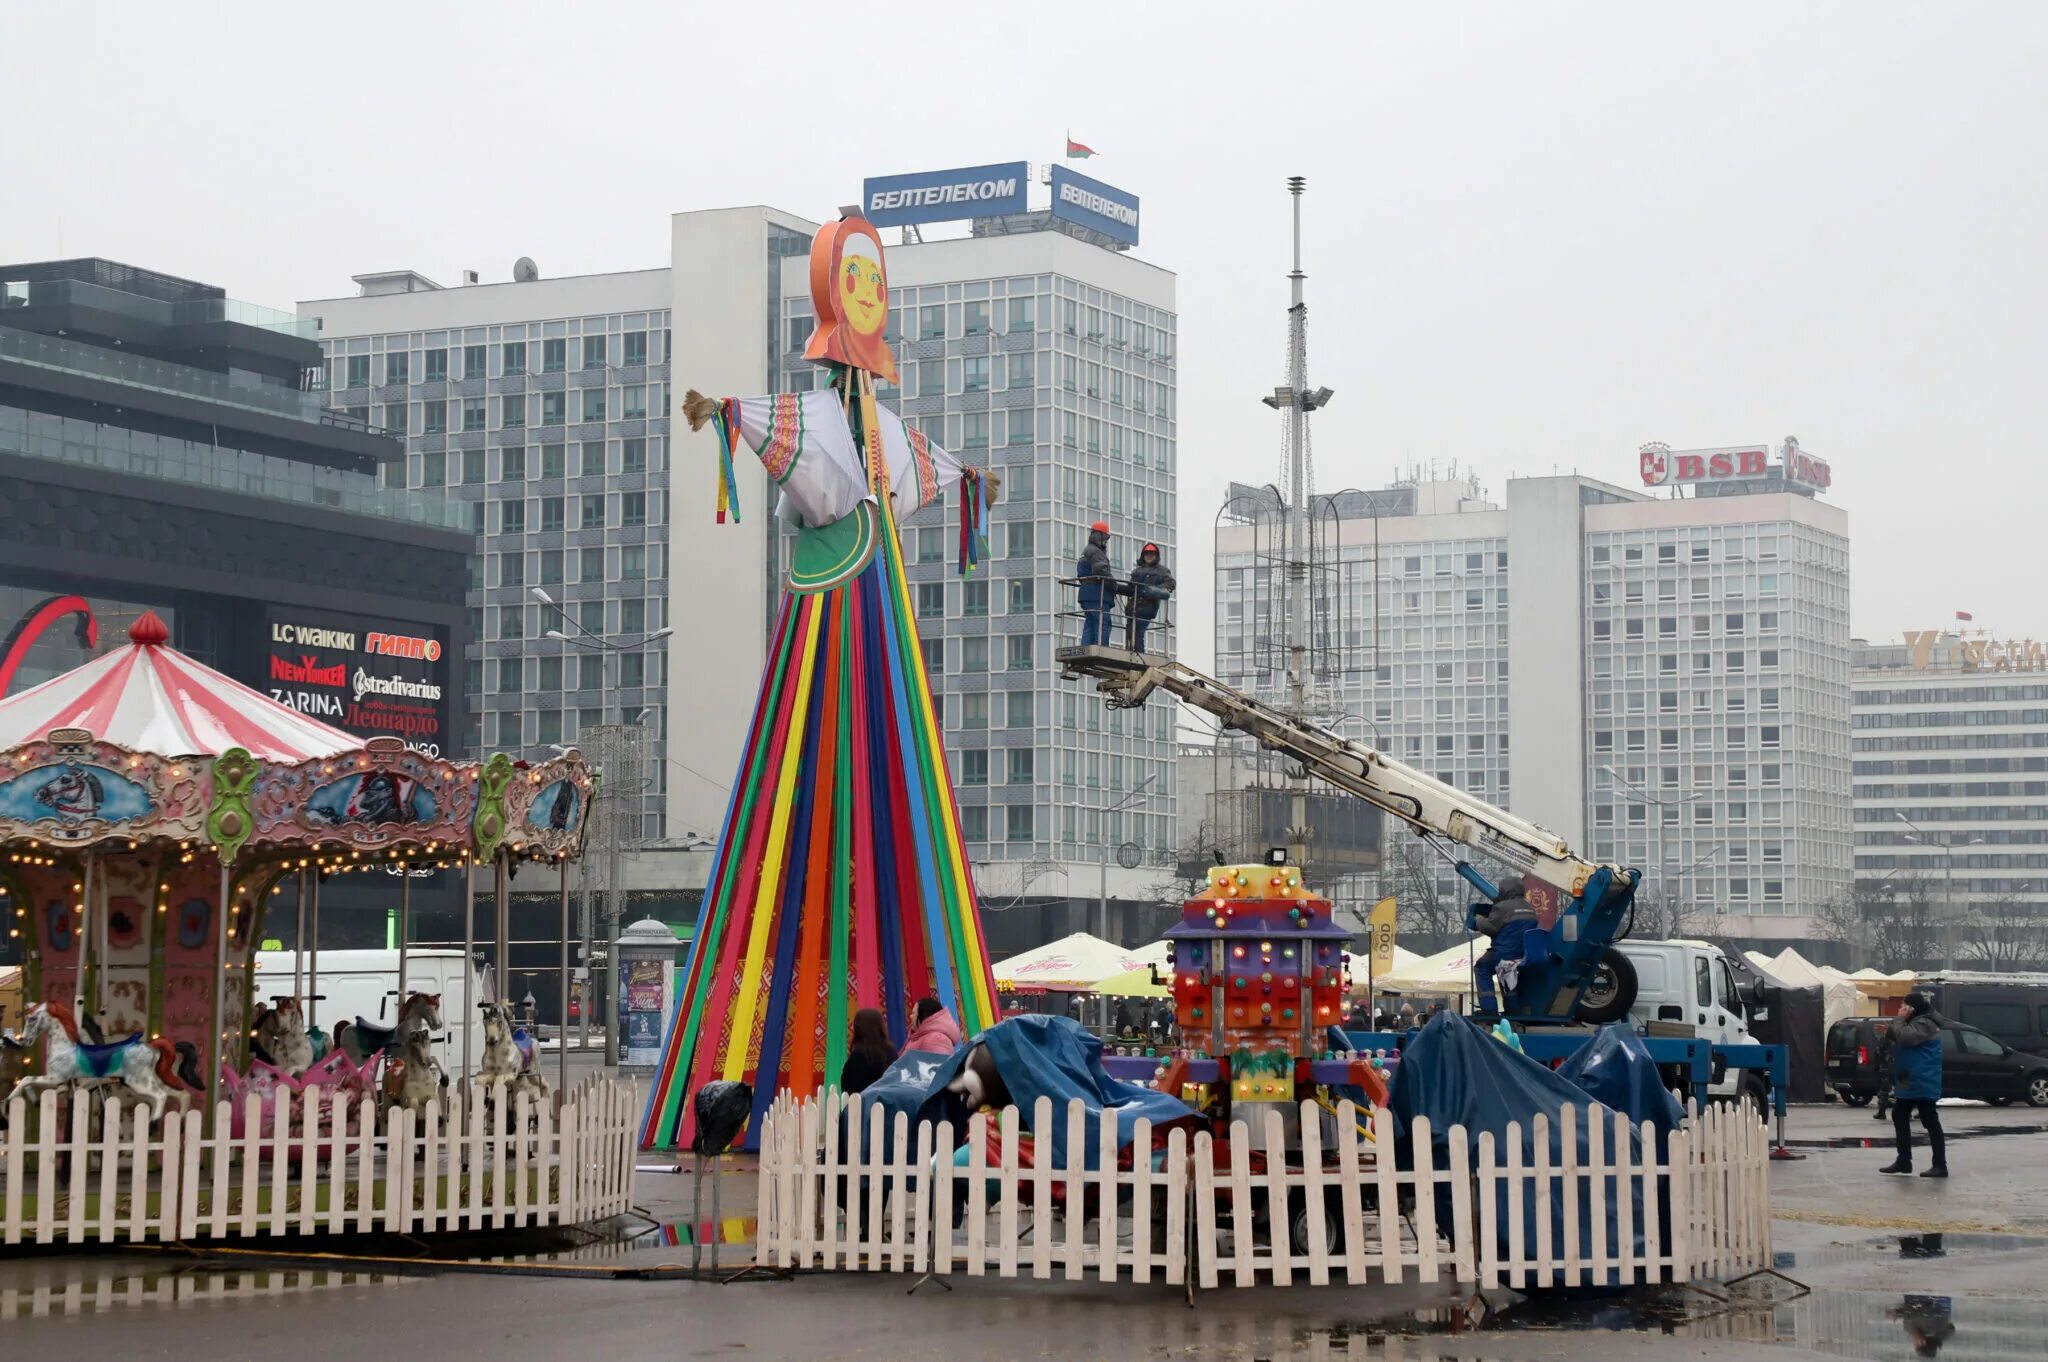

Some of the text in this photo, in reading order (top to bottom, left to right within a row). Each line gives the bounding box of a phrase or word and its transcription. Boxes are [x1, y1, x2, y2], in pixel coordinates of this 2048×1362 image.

[870, 178, 1017, 211] БЕЛТЕЛЕКОМ
[1059, 183, 1137, 227] БЕЛТЕЛЕКОМ
[1675, 450, 1767, 480] BSB
[1797, 455, 1832, 488] BSB
[272, 623, 295, 643] LC
[365, 632, 442, 662] ГИППО
[269, 688, 344, 717] ZARINA
[364, 674, 441, 701] stradivarius
[342, 703, 439, 736] Леонардо
[1379, 923, 1391, 960] FOOD
